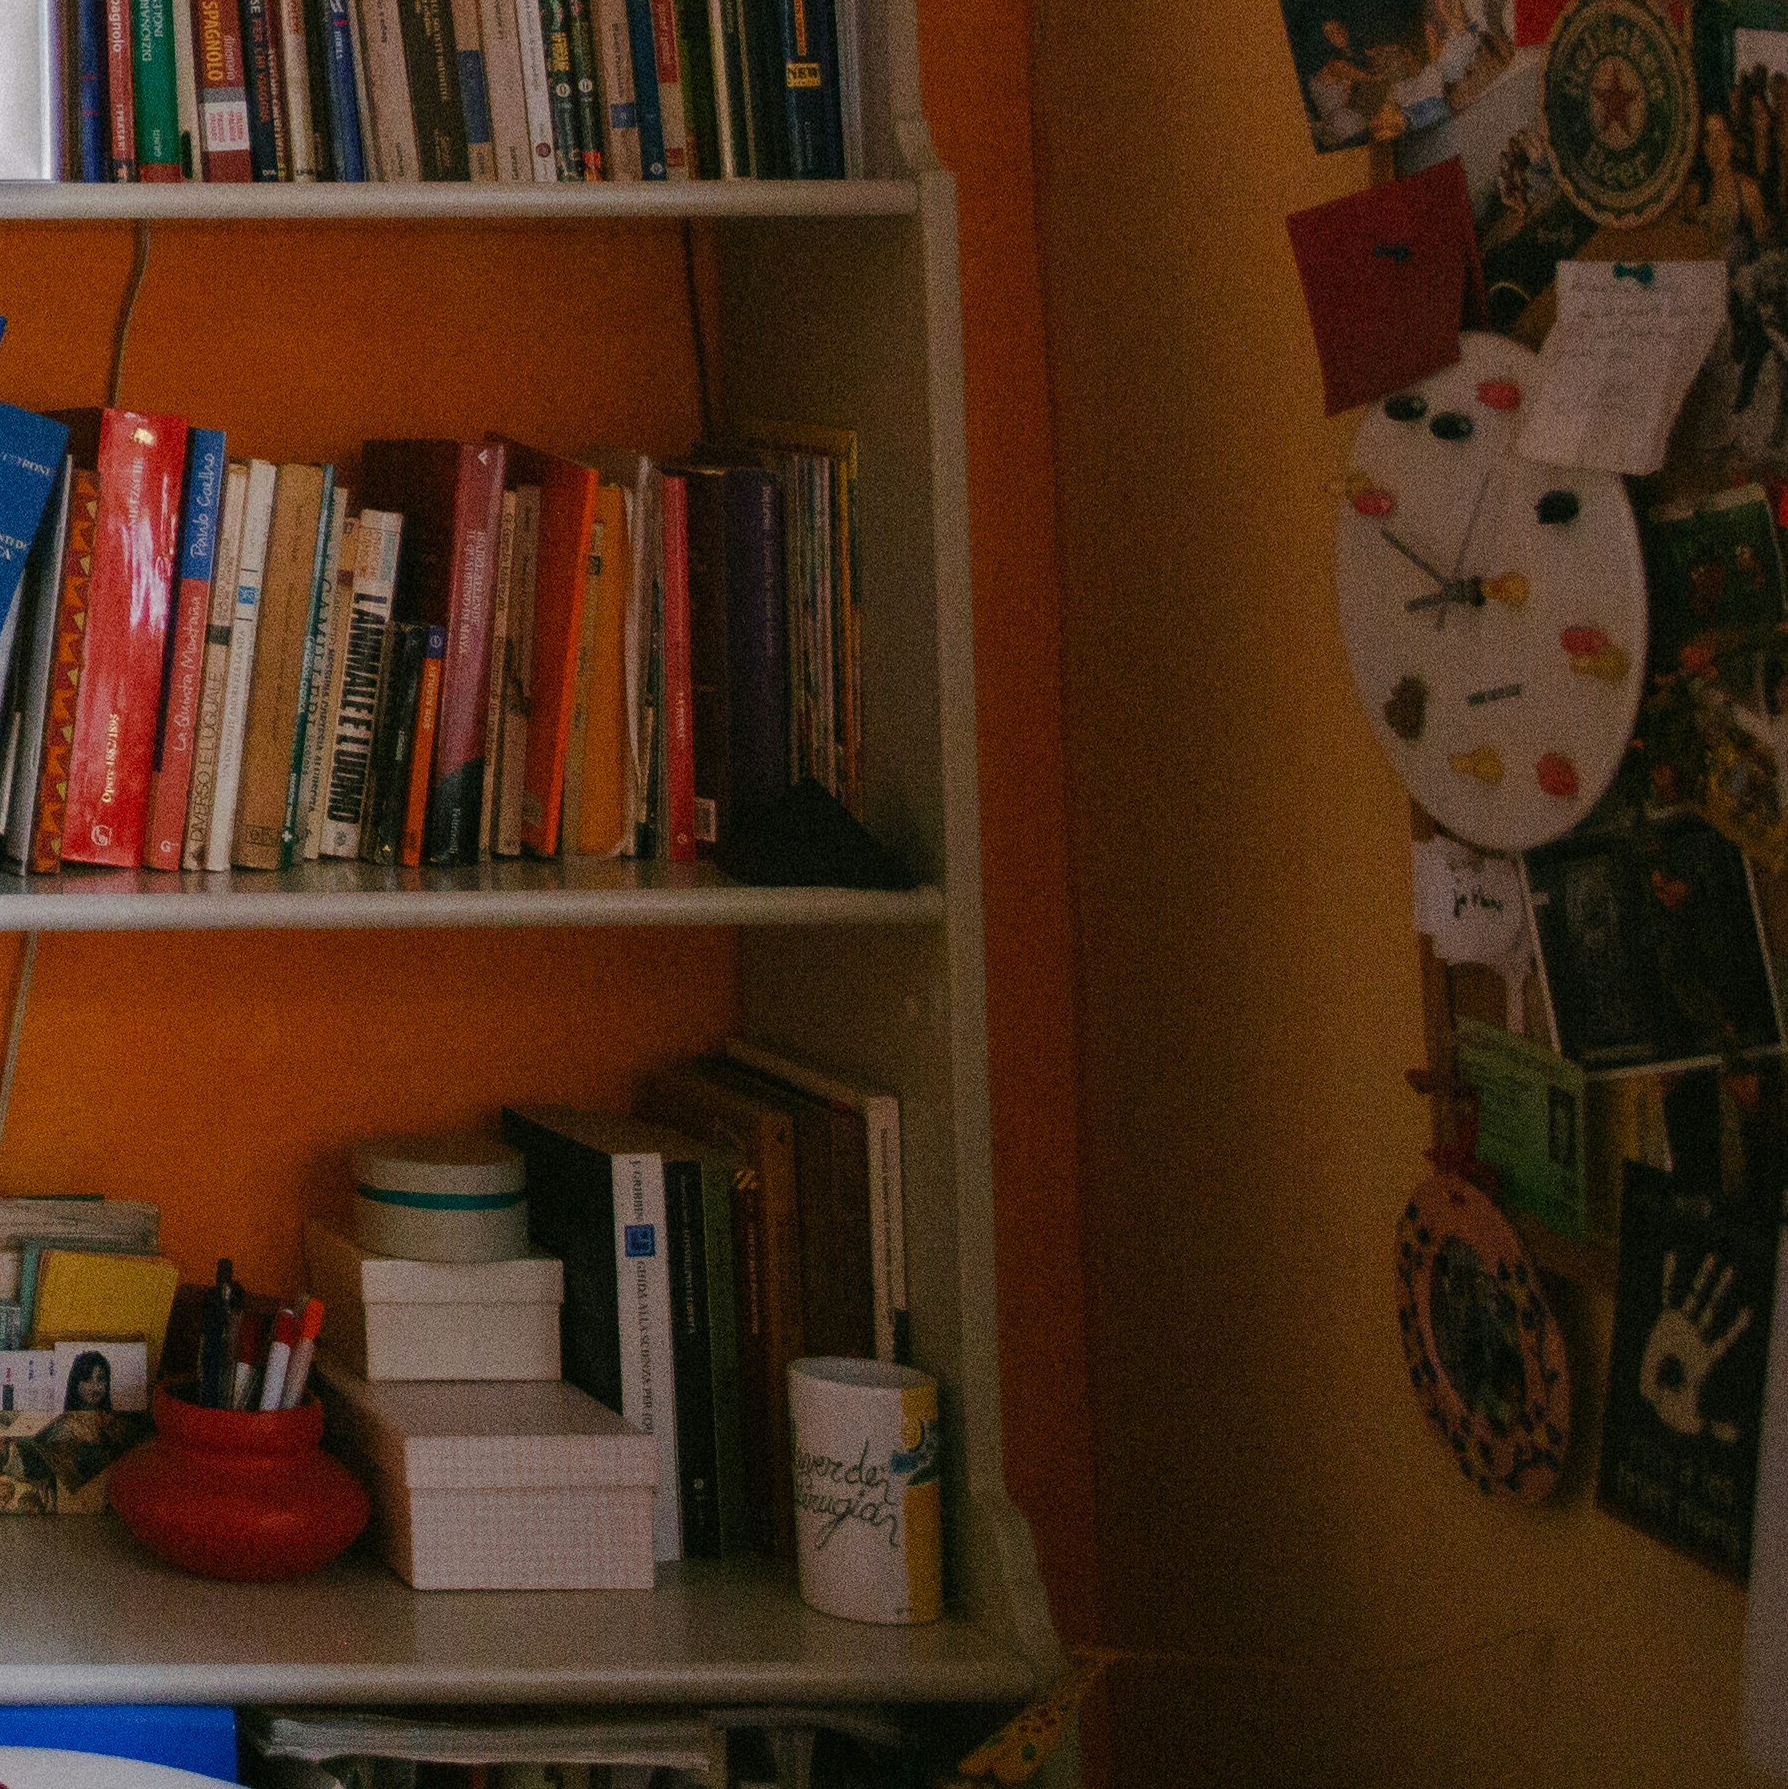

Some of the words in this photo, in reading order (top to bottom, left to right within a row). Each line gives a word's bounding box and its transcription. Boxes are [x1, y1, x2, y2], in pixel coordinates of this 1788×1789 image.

[201, 0, 223, 81] SPAGNOLO
[198, 453, 216, 506] Coelho
[191, 514, 209, 557] Paulo
[173, 674, 190, 727] Quinta
[173, 731, 187, 751] La
[638, 1304, 649, 1332] ALLA
[642, 1388, 652, 1408] PER
